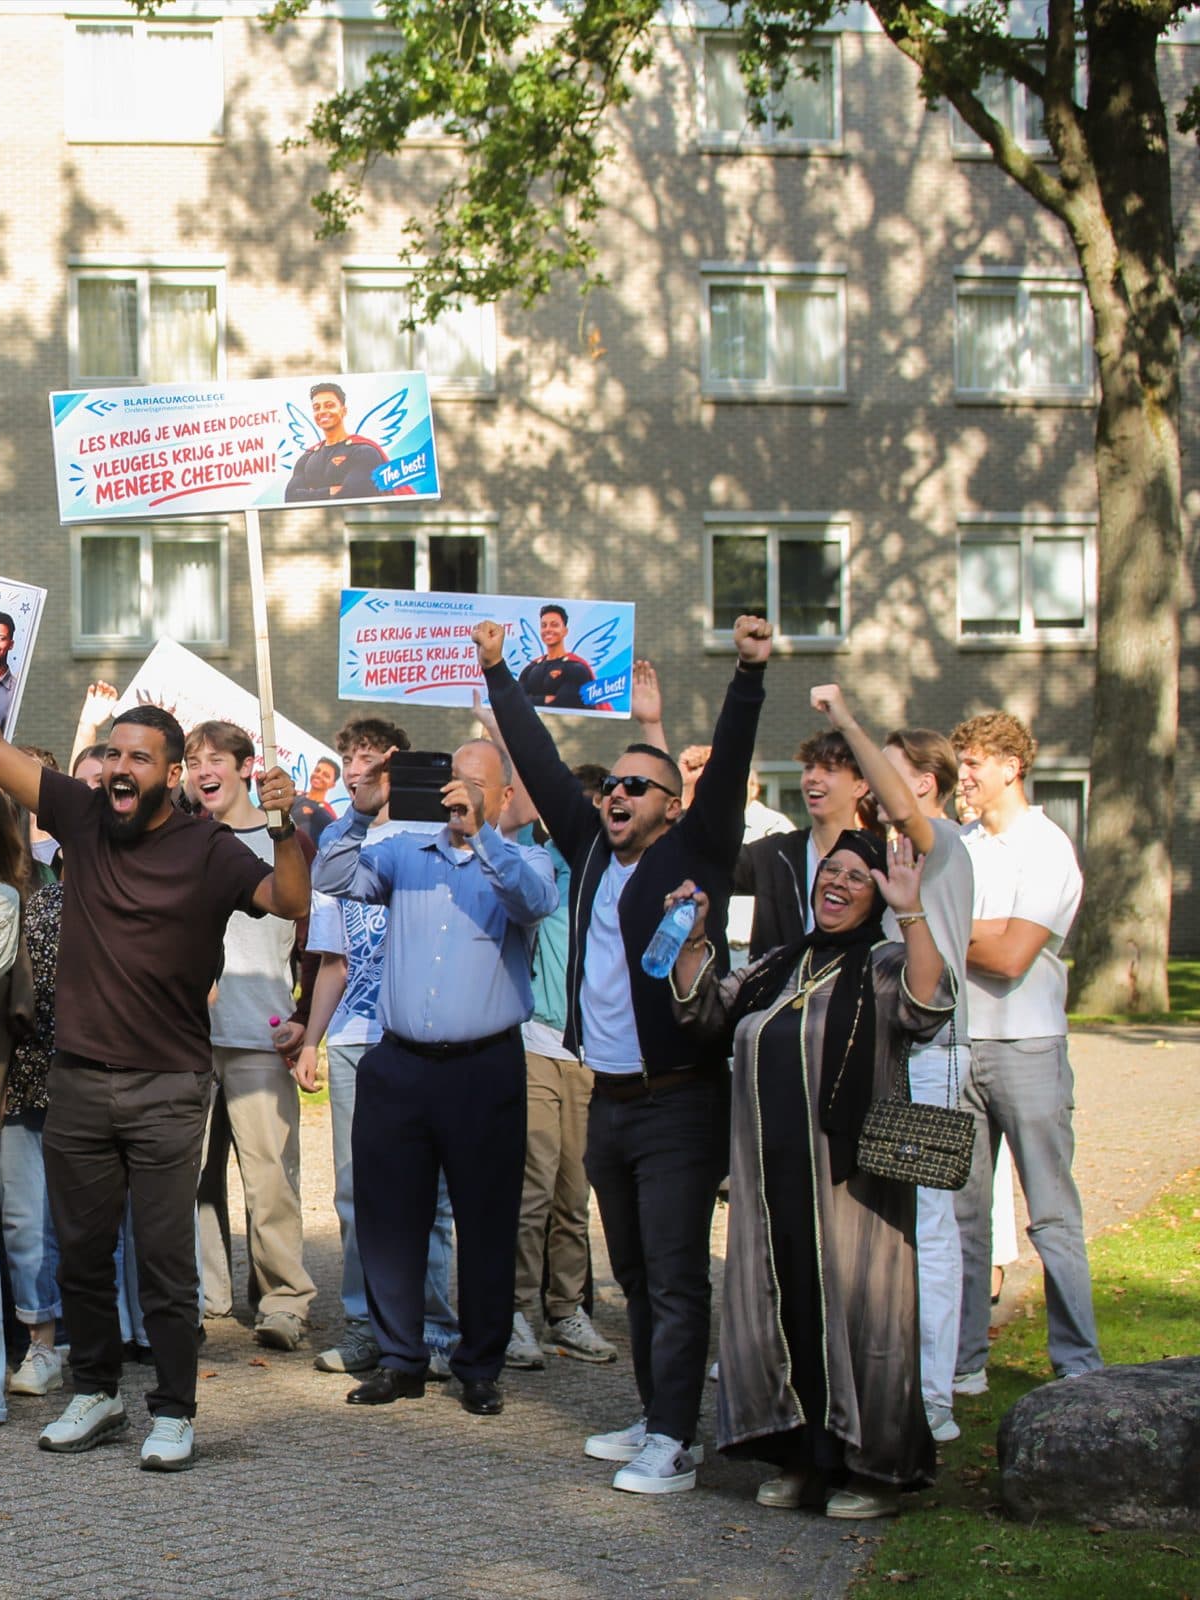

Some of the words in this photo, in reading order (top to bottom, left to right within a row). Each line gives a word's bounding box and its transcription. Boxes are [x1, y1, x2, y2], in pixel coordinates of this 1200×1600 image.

[124, 393, 225, 407] BLARIACUMCOLLEGE
[79, 436, 106, 455] LES
[110, 428, 151, 449] KRIJG
[155, 426, 169, 441] JE
[172, 422, 201, 438] VAN
[204, 418, 226, 434] EEN
[230, 409, 281, 429] DOCENT,
[93, 451, 168, 479] VLEUGELS
[173, 445, 214, 466] KRIJG
[219, 443, 233, 457] JE
[237, 437, 264, 452] VAN
[95, 470, 176, 505] MENEER
[181, 453, 277, 487] CHETOUANI!
[379, 467, 400, 486] The
[401, 453, 426, 472] best!
[394, 600, 474, 611] BLARIACUMCOLLEGE
[356, 628, 377, 643] LES
[380, 627, 412, 641] KRIJG
[415, 626, 427, 640] JE
[430, 625, 451, 638] VAN
[453, 625, 472, 637] EEN
[365, 649, 423, 665] VLEUGELS
[426, 646, 459, 661] KRIJG
[462, 646, 475, 659] JE
[365, 666, 427, 687] MENEER
[587, 684, 602, 700] The
[604, 676, 626, 693] best!
